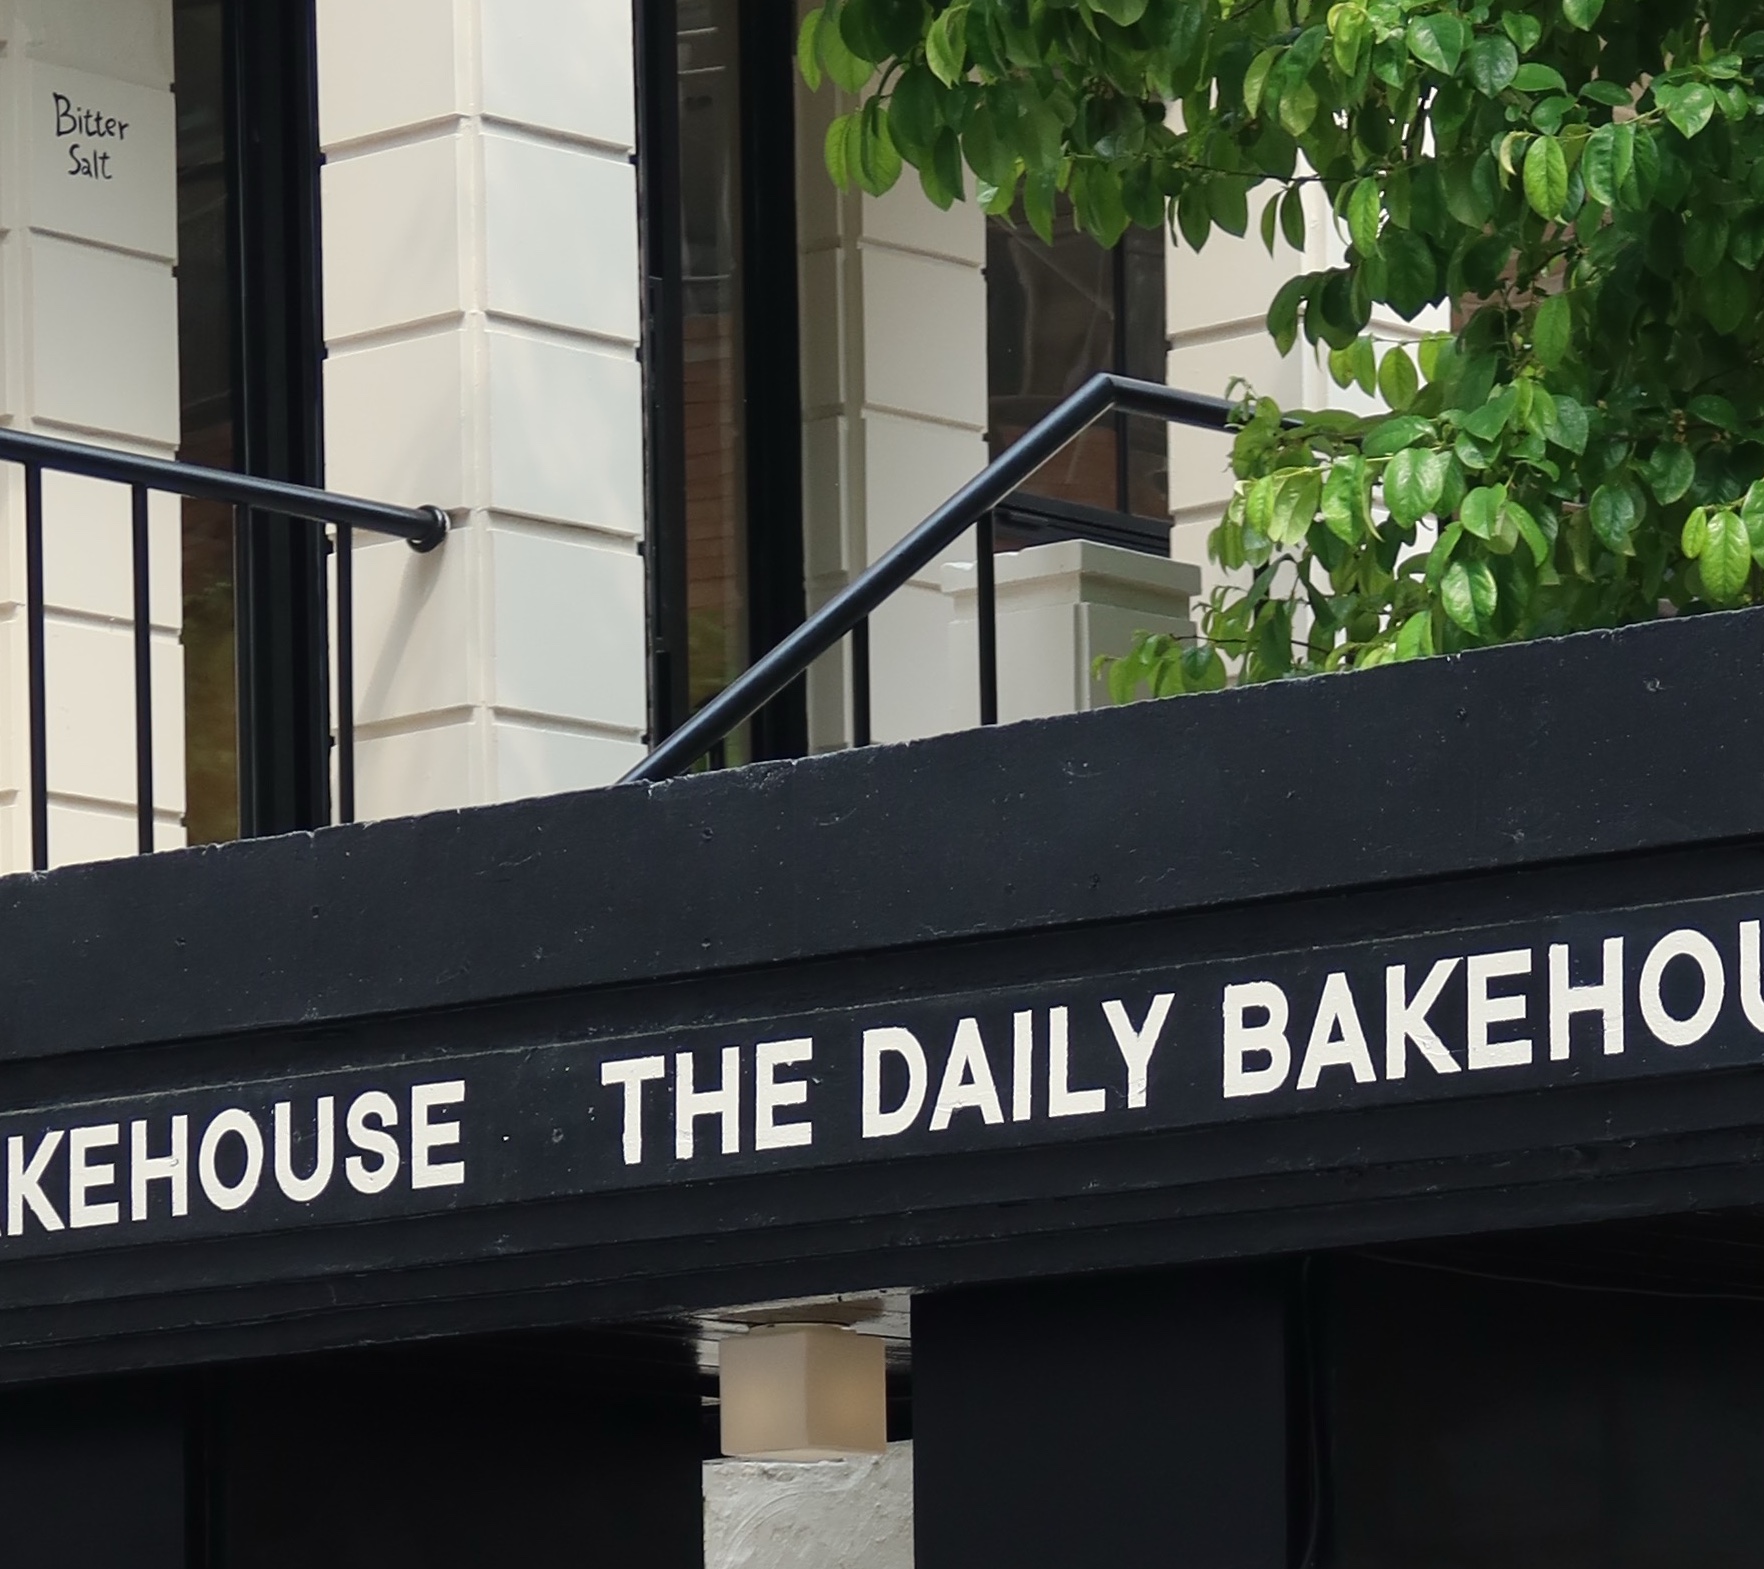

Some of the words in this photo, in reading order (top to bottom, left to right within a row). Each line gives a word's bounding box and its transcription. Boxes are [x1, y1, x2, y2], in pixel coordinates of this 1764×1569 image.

[53, 92, 129, 140] Bitter
[68, 143, 112, 180] Salt
[601, 1037, 813, 1165] THE
[862, 992, 1176, 1139] DAILY
[0, 1080, 466, 1236] KEHOUSE
